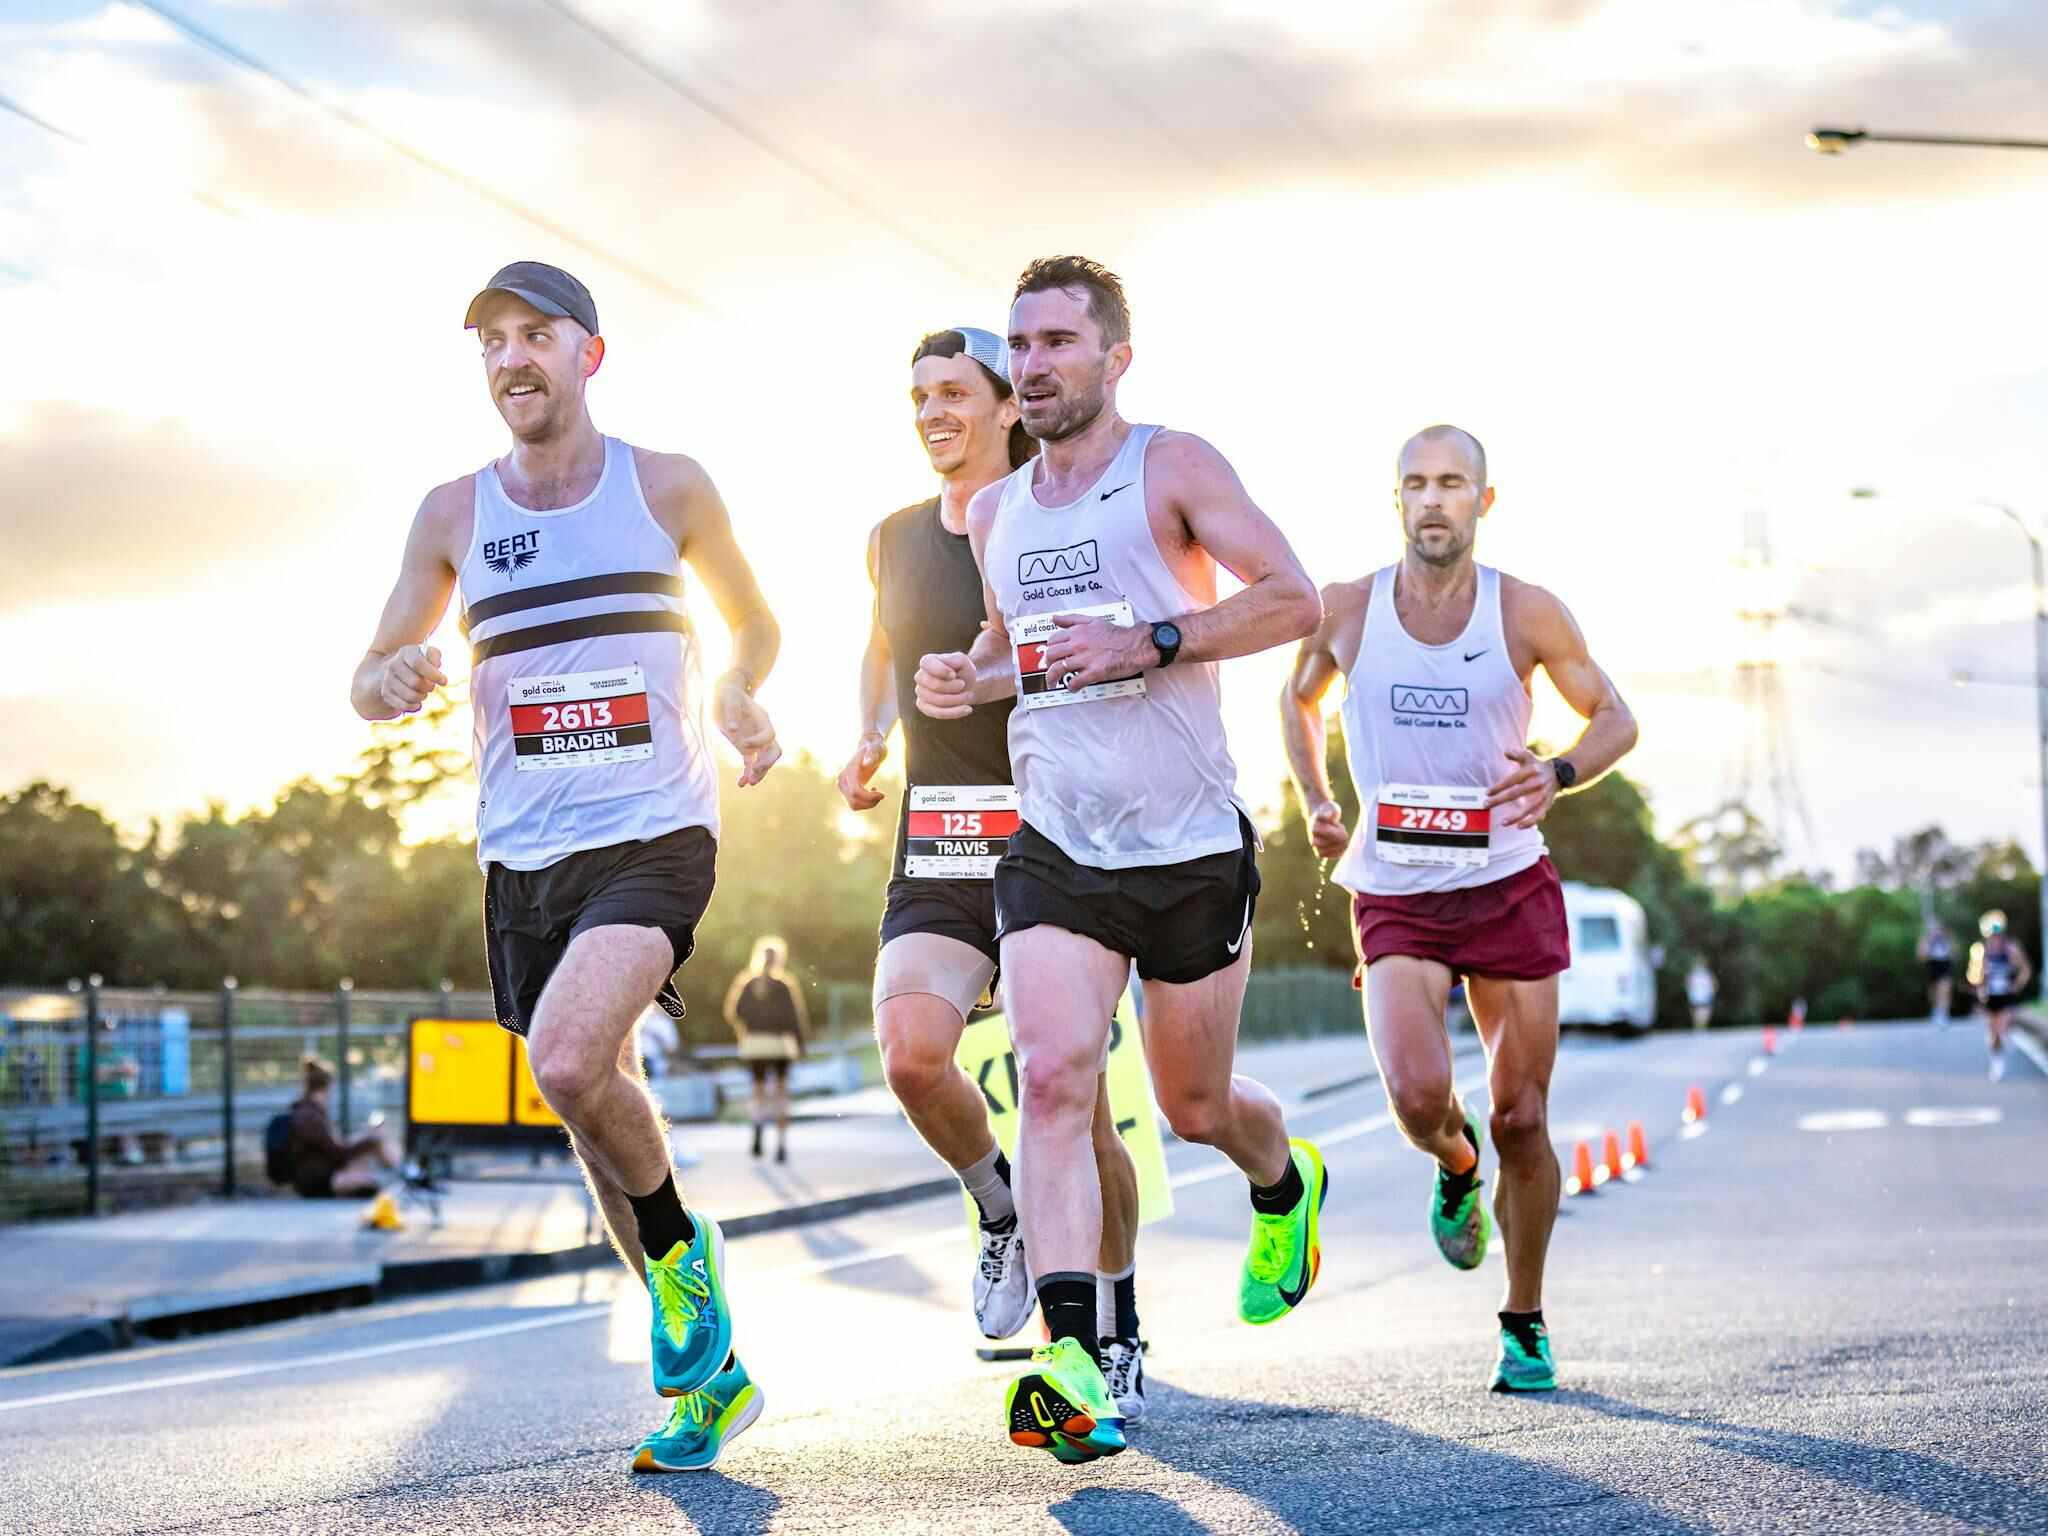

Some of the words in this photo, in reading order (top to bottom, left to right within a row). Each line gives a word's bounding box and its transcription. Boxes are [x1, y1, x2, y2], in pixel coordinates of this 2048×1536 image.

[484, 530, 540, 560] BERT
[1023, 587, 1045, 601] Gold
[1047, 585, 1072, 598] Coast
[1075, 584, 1087, 594] Run
[1088, 581, 1103, 591] Co.
[1024, 623, 1038, 637] gold
[522, 685, 541, 698] gold
[542, 685, 566, 694] coast
[542, 701, 613, 731] 2613
[1393, 716, 1412, 727] Gold
[1414, 718, 1436, 728] Coast
[1438, 719, 1452, 728] Run
[542, 731, 618, 753] BRADEN
[942, 813, 983, 836] 125
[1400, 807, 1468, 831] 2749
[935, 841, 989, 855] TRAVIS
